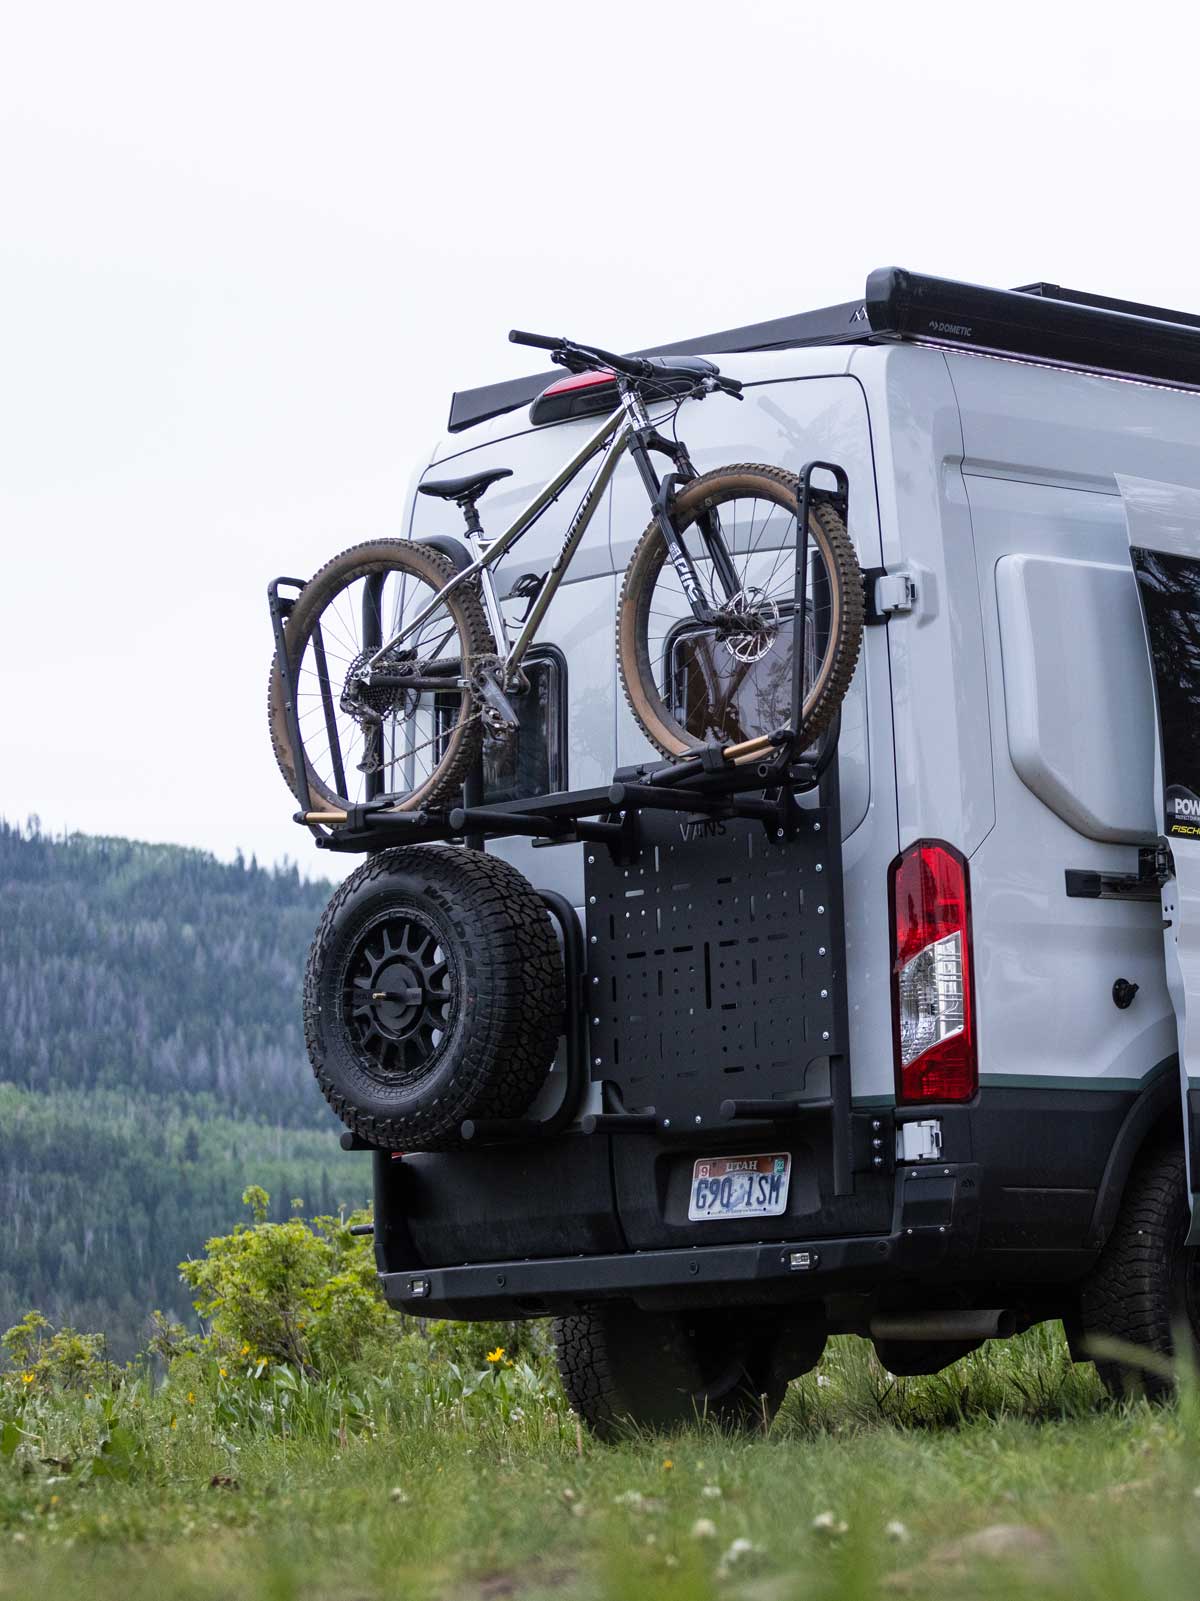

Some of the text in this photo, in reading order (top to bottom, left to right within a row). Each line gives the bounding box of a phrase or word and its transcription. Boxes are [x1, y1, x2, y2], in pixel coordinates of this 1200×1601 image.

[938, 323, 973, 337] DOMETIC
[679, 821, 727, 842] VANS
[700, 1166, 709, 1177] 9
[725, 1160, 758, 1172] UTAH
